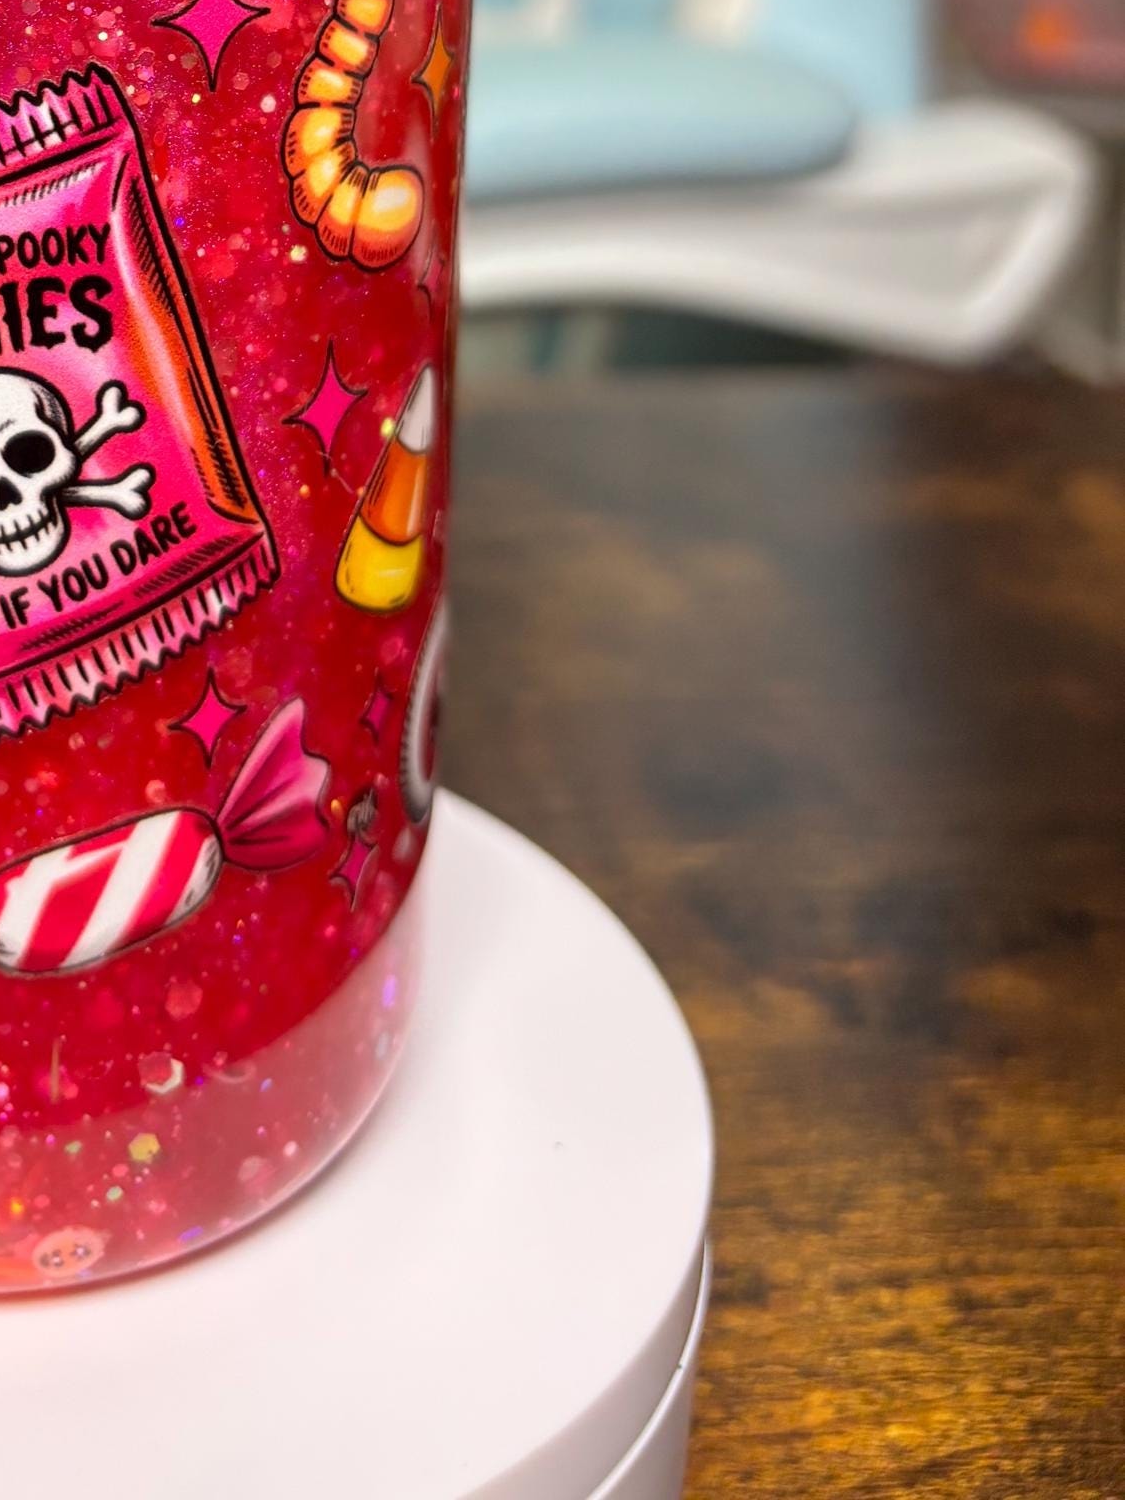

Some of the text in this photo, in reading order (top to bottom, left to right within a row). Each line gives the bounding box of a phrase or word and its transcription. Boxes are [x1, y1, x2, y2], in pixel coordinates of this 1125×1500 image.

[1, 586, 30, 630] IF
[37, 553, 111, 613] YOU
[109, 502, 197, 576] DARE
